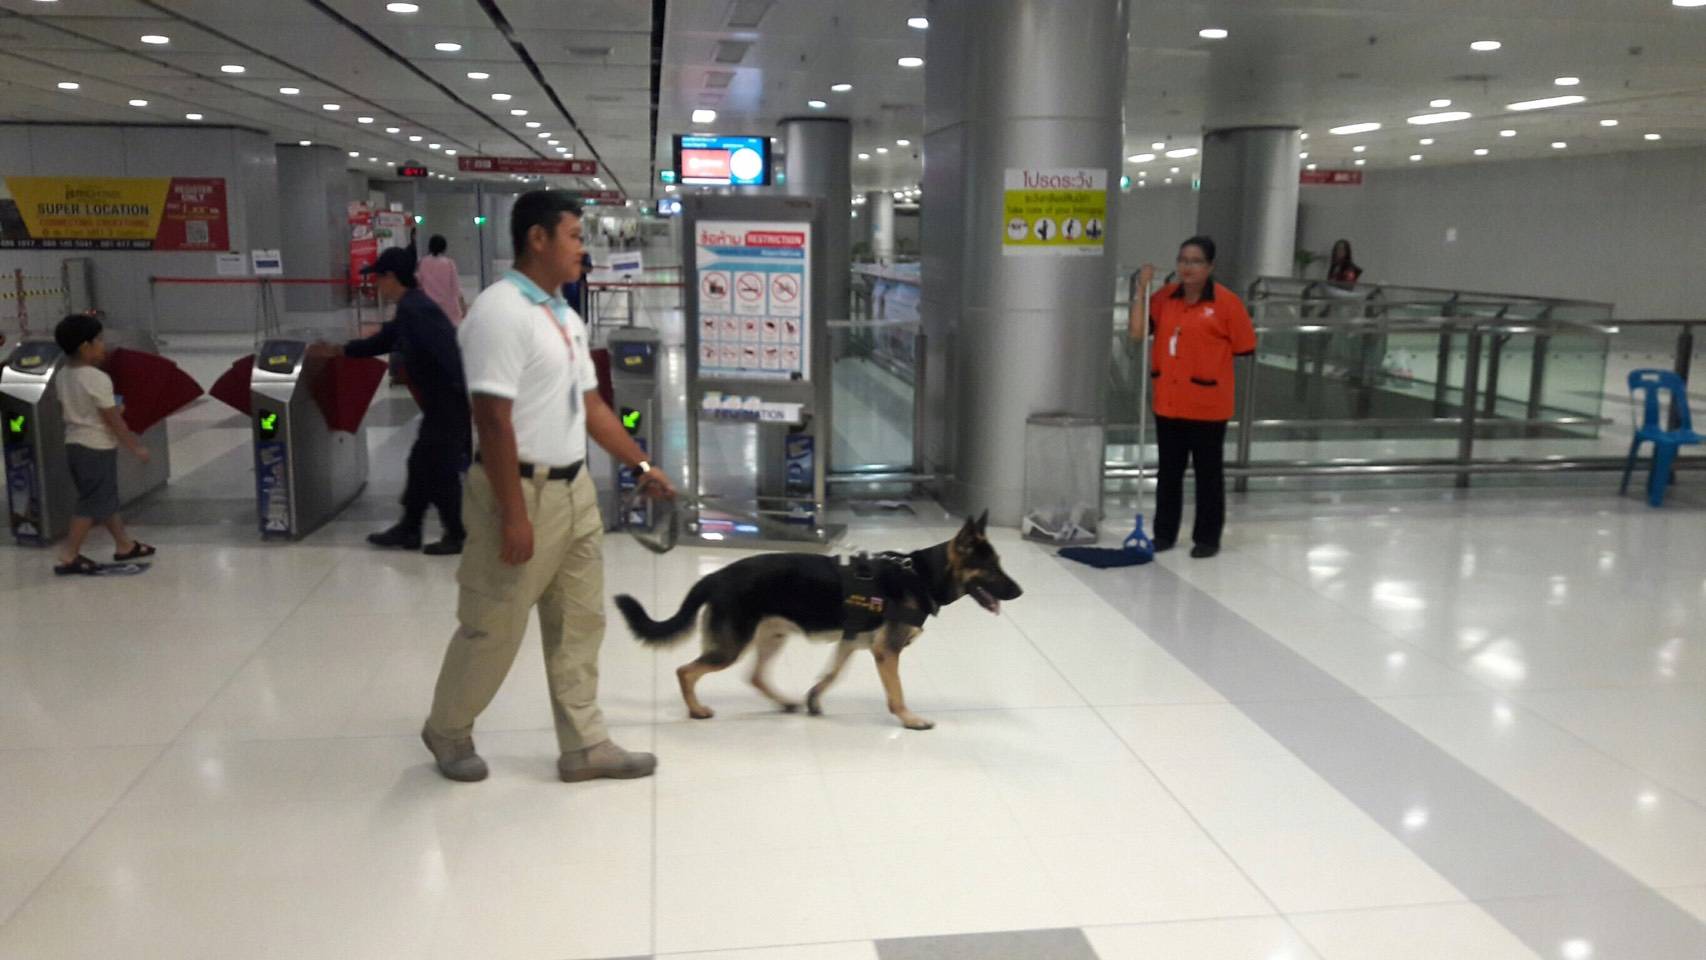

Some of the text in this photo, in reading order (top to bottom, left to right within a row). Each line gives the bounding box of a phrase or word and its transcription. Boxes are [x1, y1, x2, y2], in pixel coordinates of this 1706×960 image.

[1023, 169, 1093, 188] โปรดระวัง
[37, 203, 149, 216] SUPER LOCATION
[747, 233, 802, 245] RESTRICTION
